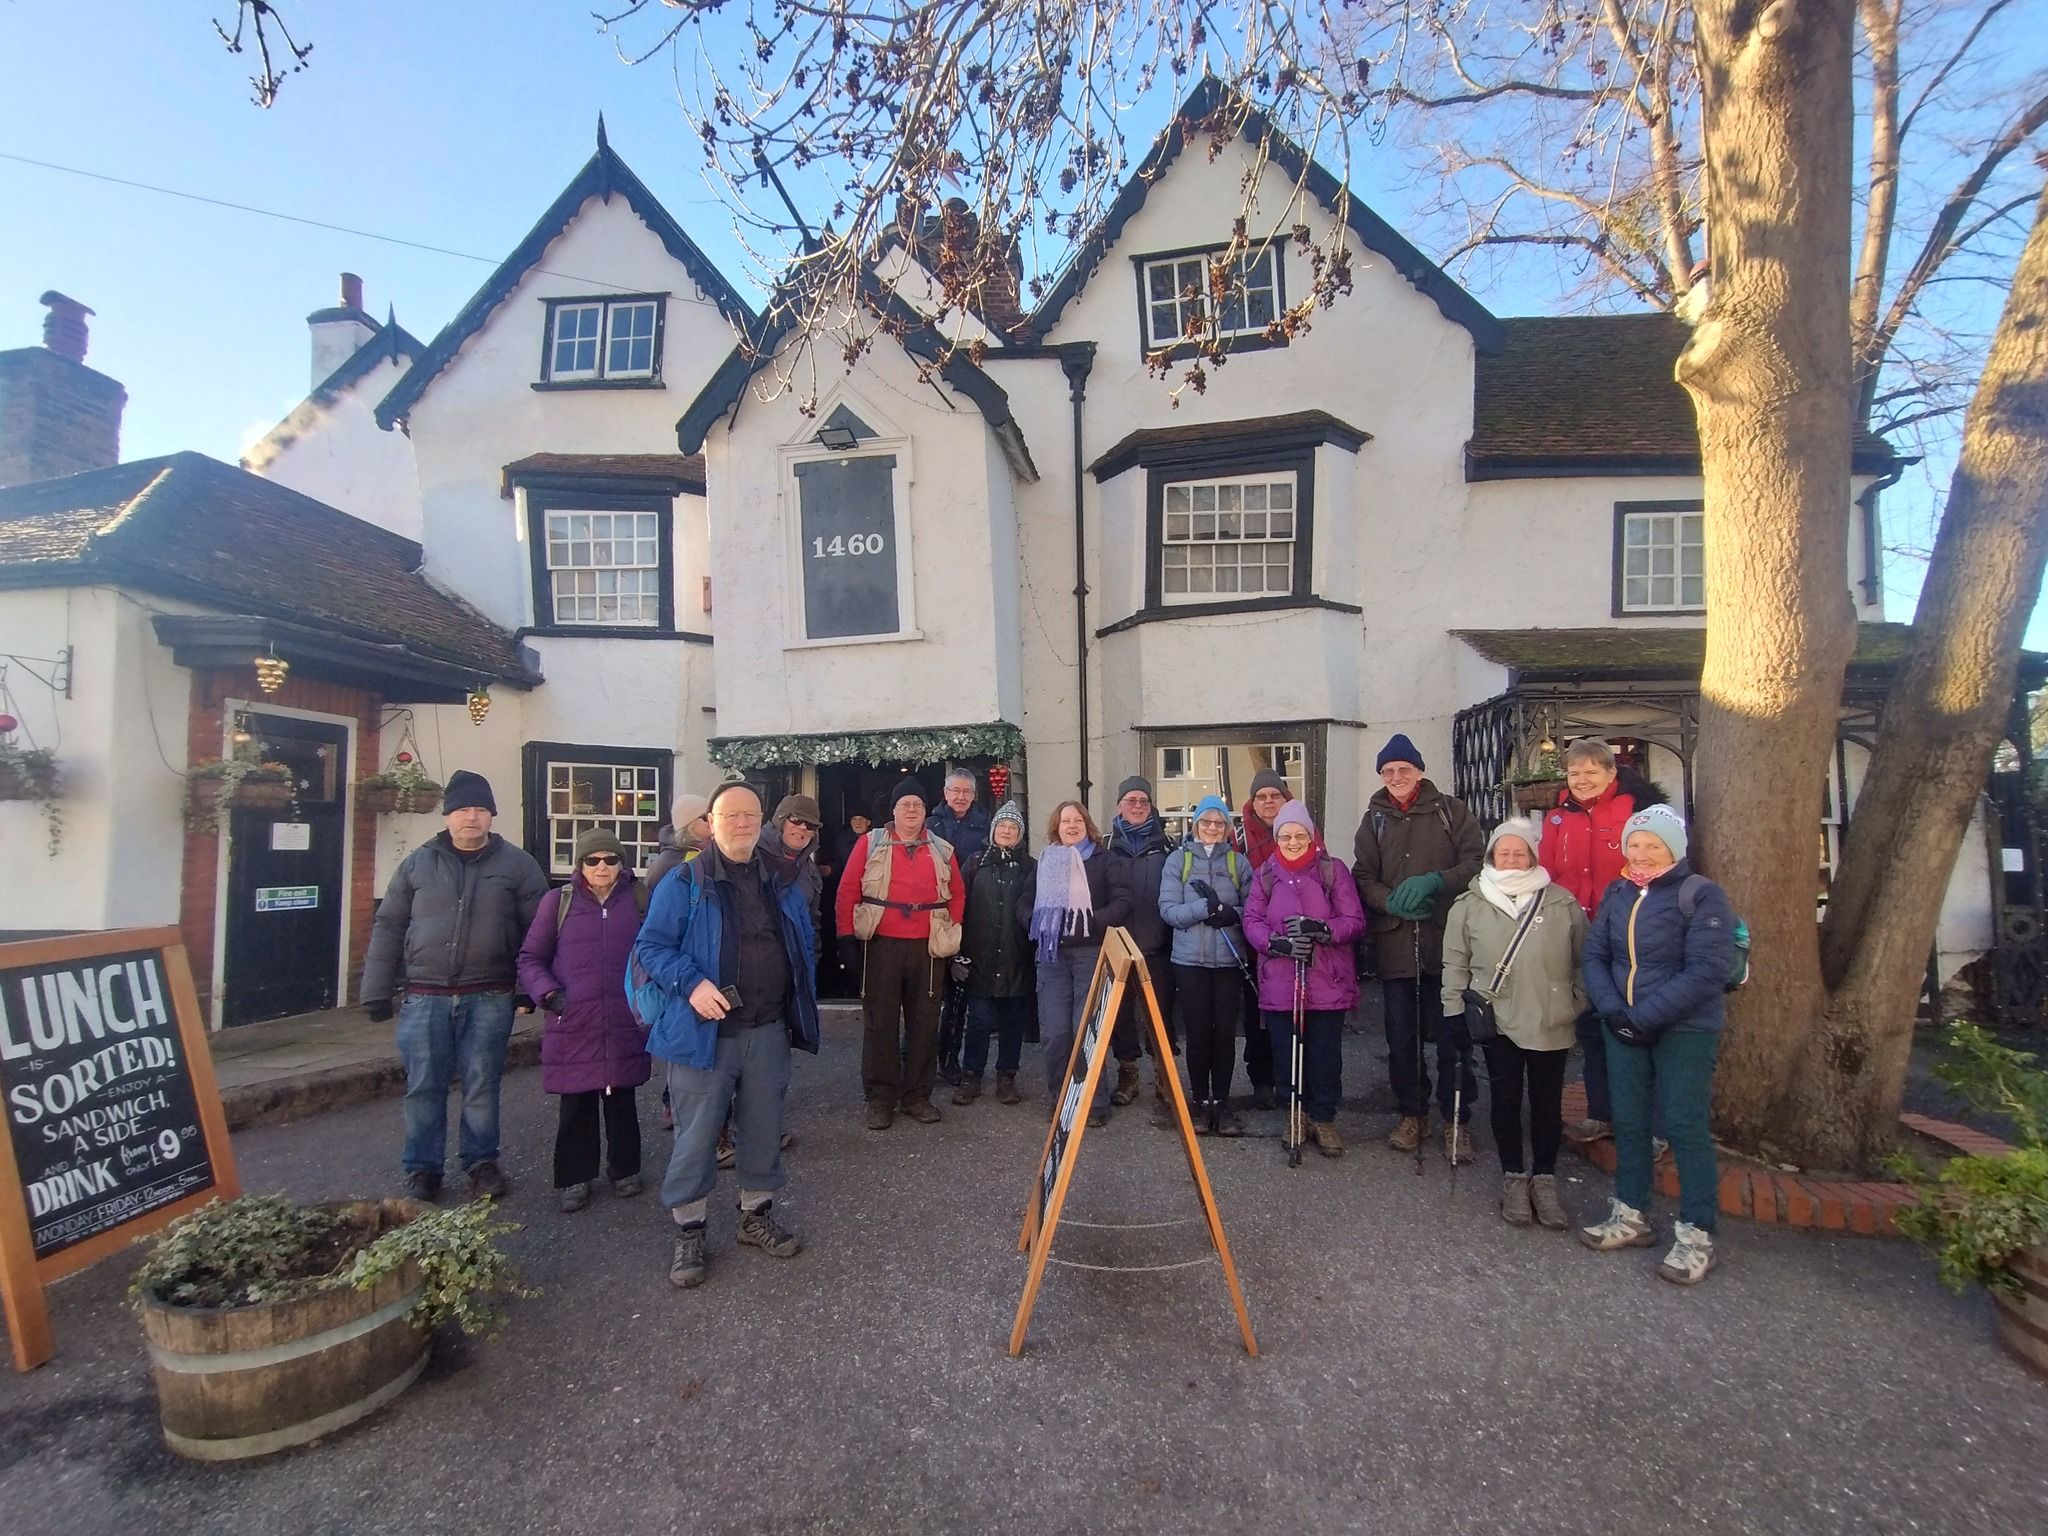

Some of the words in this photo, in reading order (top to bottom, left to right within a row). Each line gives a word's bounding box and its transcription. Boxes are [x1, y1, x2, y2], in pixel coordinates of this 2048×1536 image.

[813, 533, 884, 558] 1460
[0, 958, 168, 1060] LUNCH
[9, 1036, 175, 1123] SORTED!
[108, 1077, 152, 1098] ENJOY
[156, 1074, 168, 1084] A
[73, 1135, 90, 1156] A
[120, 1144, 149, 1167] from
[125, 1160, 151, 1176] ONLY
[26, 1156, 121, 1218] DRINK
